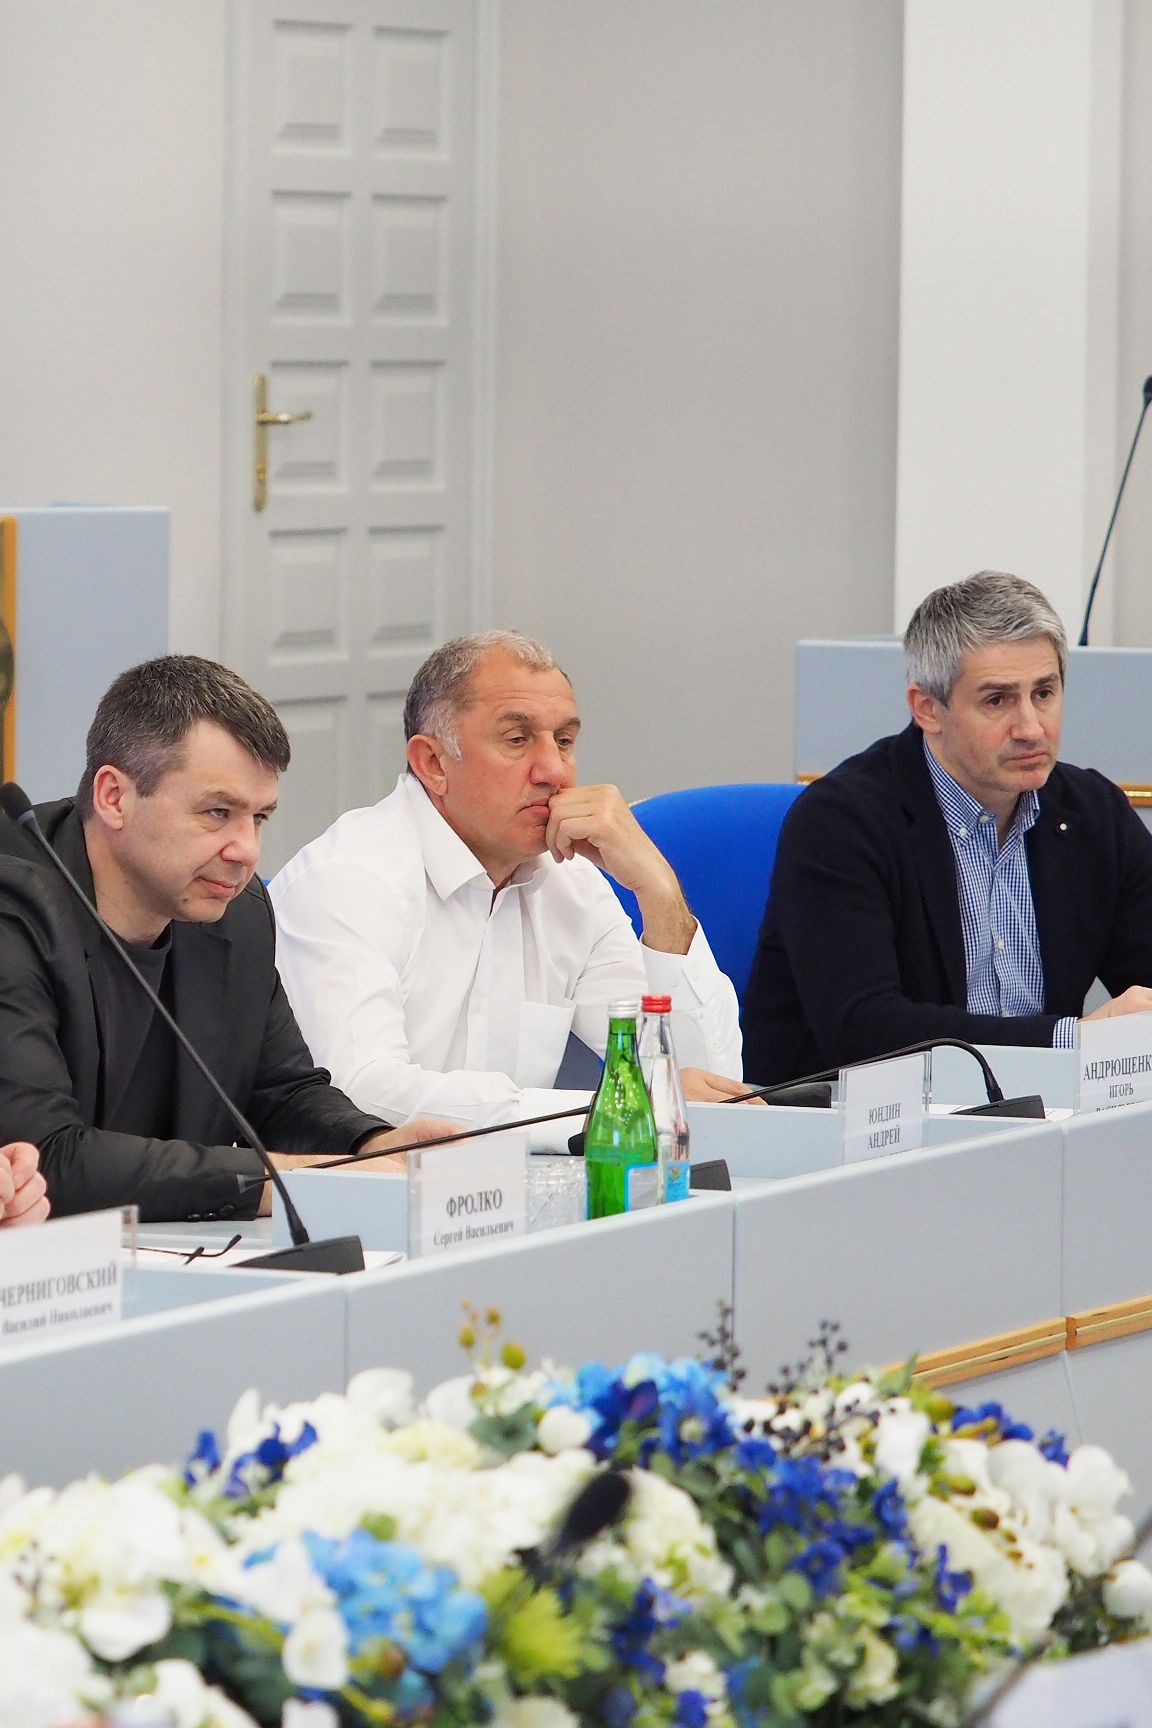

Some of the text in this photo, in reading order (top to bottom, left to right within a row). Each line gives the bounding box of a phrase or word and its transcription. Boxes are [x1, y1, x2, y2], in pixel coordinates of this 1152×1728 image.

[1083, 1054, 1152, 1081] АНДРЮЩЕНК
[1109, 1083, 1134, 1098] ИГОРЬ
[868, 1103, 901, 1124] ЮНДИН
[867, 1125, 900, 1149] АНДРЕЙ
[446, 1188, 503, 1218] ФРОЛКО
[433, 1220, 514, 1248] Сергей Васильевич
